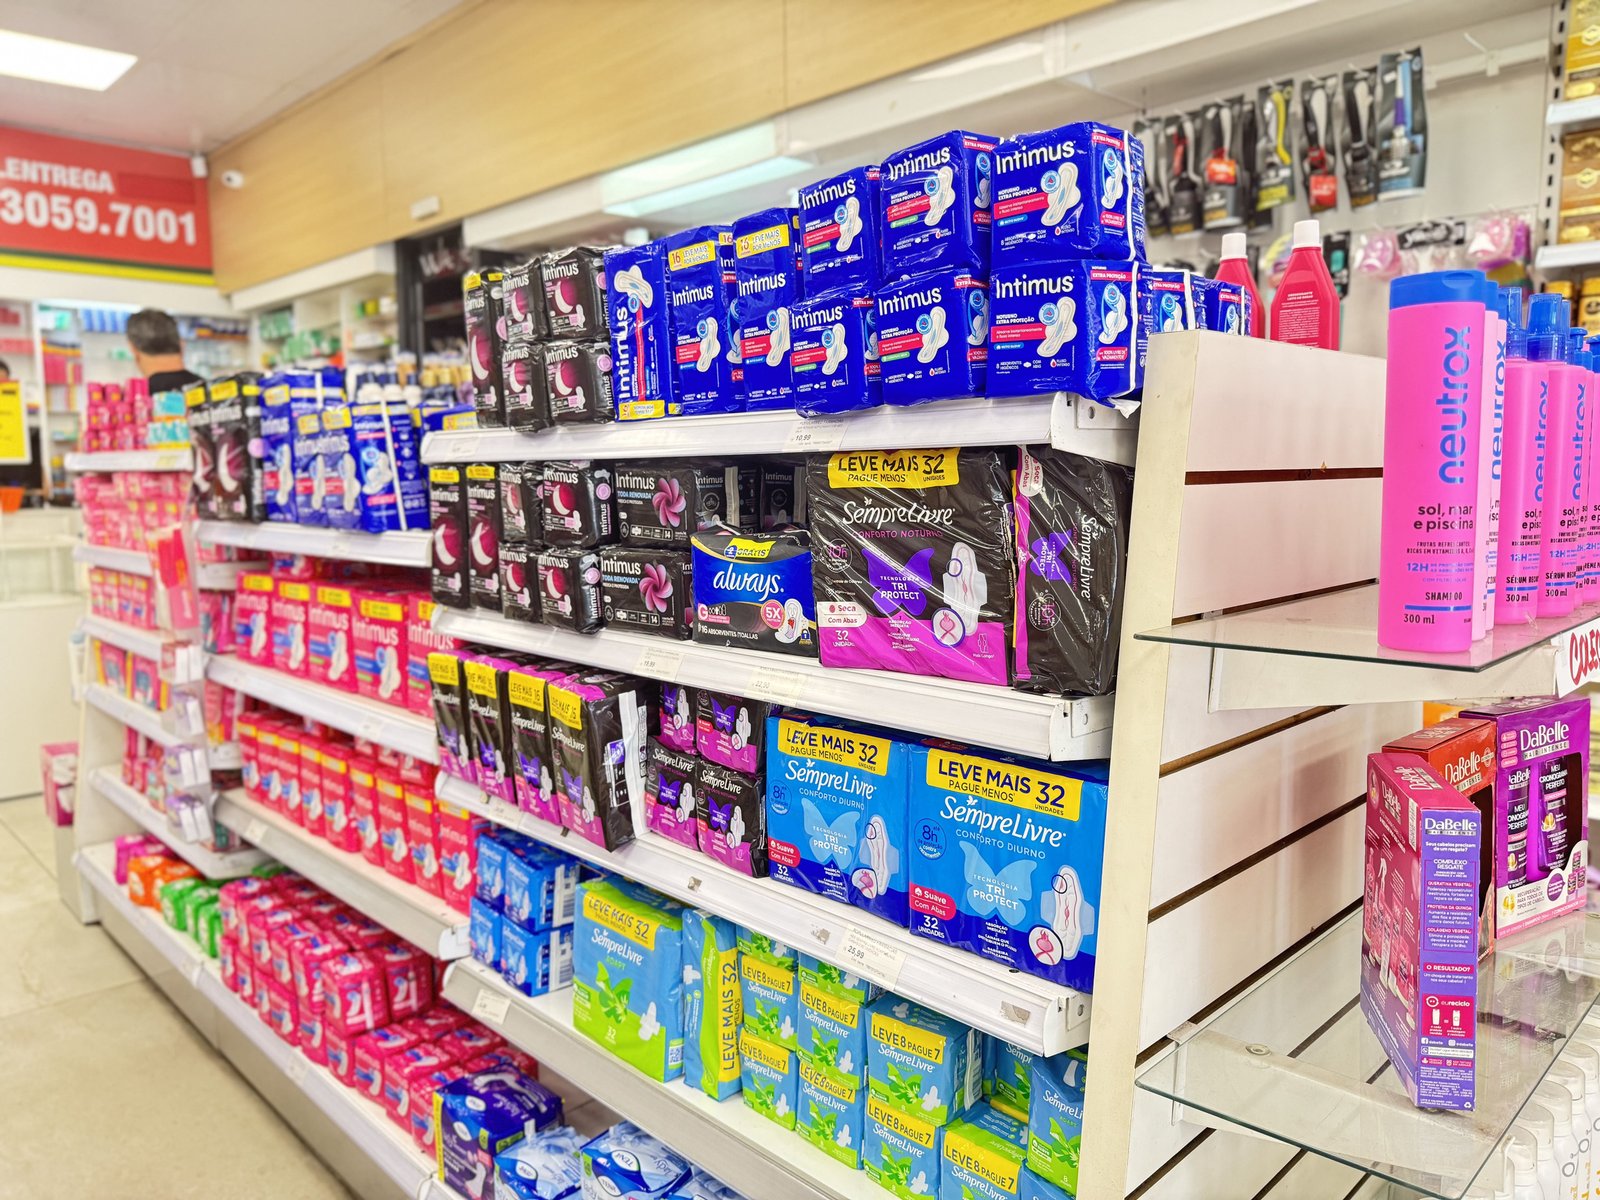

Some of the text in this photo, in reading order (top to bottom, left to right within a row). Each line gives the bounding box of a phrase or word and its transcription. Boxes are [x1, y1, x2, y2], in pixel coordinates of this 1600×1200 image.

[888, 146, 951, 181] Intimus
[996, 141, 1075, 174] Intimus
[802, 179, 856, 210] Intimus
[672, 252, 681, 265] 16
[543, 263, 579, 281] Intimus
[738, 273, 786, 297] Intimus
[996, 274, 1075, 298] Intimus
[672, 285, 714, 307] Intimus
[879, 286, 942, 315] Intimus
[791, 305, 843, 330] Intimus
[545, 347, 579, 363] Intimus
[616, 306, 629, 398] Intimus
[1436, 326, 1471, 485] neutrox
[838, 453, 945, 475] LEVE MAIS 32
[543, 467, 579, 484] Intimus
[615, 472, 655, 490] Intimus
[696, 476, 723, 484] Intimus
[765, 473, 792, 482] Intimus
[847, 474, 906, 483] PAGUE MENOS
[842, 500, 954, 530] SempreLivre
[1418, 503, 1445, 516] sol,
[1413, 517, 1473, 532] e piscina
[601, 556, 642, 574] Intimus
[1080, 514, 1097, 602] SempreLivre
[1407, 563, 1429, 572] 12H
[614, 576, 639, 584] RENOVADA
[891, 582, 907, 592] TRI
[591, 587, 599, 619] Intimus
[880, 591, 920, 601] PROTECT
[1521, 594, 1529, 602] ml
[1545, 588, 1568, 597] 300 ml
[765, 607, 781, 620] 5X
[838, 604, 856, 613] Seca
[1403, 614, 1435, 625] 300 ml
[835, 630, 849, 642] 32
[551, 727, 585, 752] SempreLivre
[787, 728, 878, 765] LEVE MAIS 32
[1520, 721, 1570, 751] DaBelle
[652, 748, 694, 773] SempreLivre
[790, 746, 843, 762] PAGUE MENOS
[1524, 743, 1568, 760] HAIR INTENSE
[1445, 753, 1480, 785] DaBelle
[1551, 763, 1561, 773] MEU
[700, 769, 742, 795] SempreLivre
[785, 759, 875, 800] SempreLivre
[938, 759, 1066, 809] LEVE MAIS 32
[1545, 779, 1566, 790] PERFEITO
[772, 785, 786, 800] 8h
[799, 787, 865, 811] CONFORTO DIURNO
[948, 779, 1064, 816] PAGUE MENOS UNIDADES
[1514, 803, 1526, 813] MEU
[940, 796, 1064, 847] SempreLivre
[1424, 817, 1478, 831] DaBelle
[824, 834, 839, 844] TRI
[922, 825, 938, 843] 8h
[955, 829, 1046, 860] CONFORTO DIURNO
[770, 851, 793, 865] Com Abas
[776, 843, 795, 854] Suave
[813, 839, 848, 856] PROTECT
[774, 873, 794, 884] UNIDADES
[777, 864, 788, 877] 32
[973, 874, 1019, 892] TECNOLOGIA
[986, 884, 1006, 897] TRI
[923, 890, 947, 905] Suave
[973, 890, 1019, 911] PROTECT
[588, 896, 650, 940] LEVE MAIS 32
[914, 900, 946, 917] Com Abas
[917, 926, 945, 939] UNIDADES
[923, 915, 939, 930] 32
[591, 928, 643, 966] SempreLivre
[847, 945, 865, 959] 25,99
[742, 963, 792, 993] LEVE 8 PAGUE 7
[1433, 965, 1471, 973] RESULTADO?
[747, 980, 787, 1004] SempreLivre
[722, 959, 737, 1071] LEVE MAIS 32
[801, 988, 856, 1025] LEVE 8 PAGUE 7
[607, 1026, 617, 1040] 32
[804, 1008, 849, 1038] SempreLivre
[871, 1023, 941, 1060] LEVE 8 PAGUE 7
[739, 1038, 787, 1071] LEVE 8 PAGUE 7
[878, 1043, 934, 1073] SempreLivre
[743, 1056, 783, 1083] SempreLivre
[799, 1063, 854, 1101] LEVE 8 PAGUE 7
[802, 1082, 847, 1113] SempreLivre
[1042, 1089, 1083, 1120] SempreLi
[868, 1103, 932, 1145] LEVE 8 PAGUE 7
[872, 1122, 923, 1158] SempreLivre
[945, 1145, 1015, 1190] LEVE 8 PAGUE 7
[951, 1165, 1006, 1199] SempreLivre
